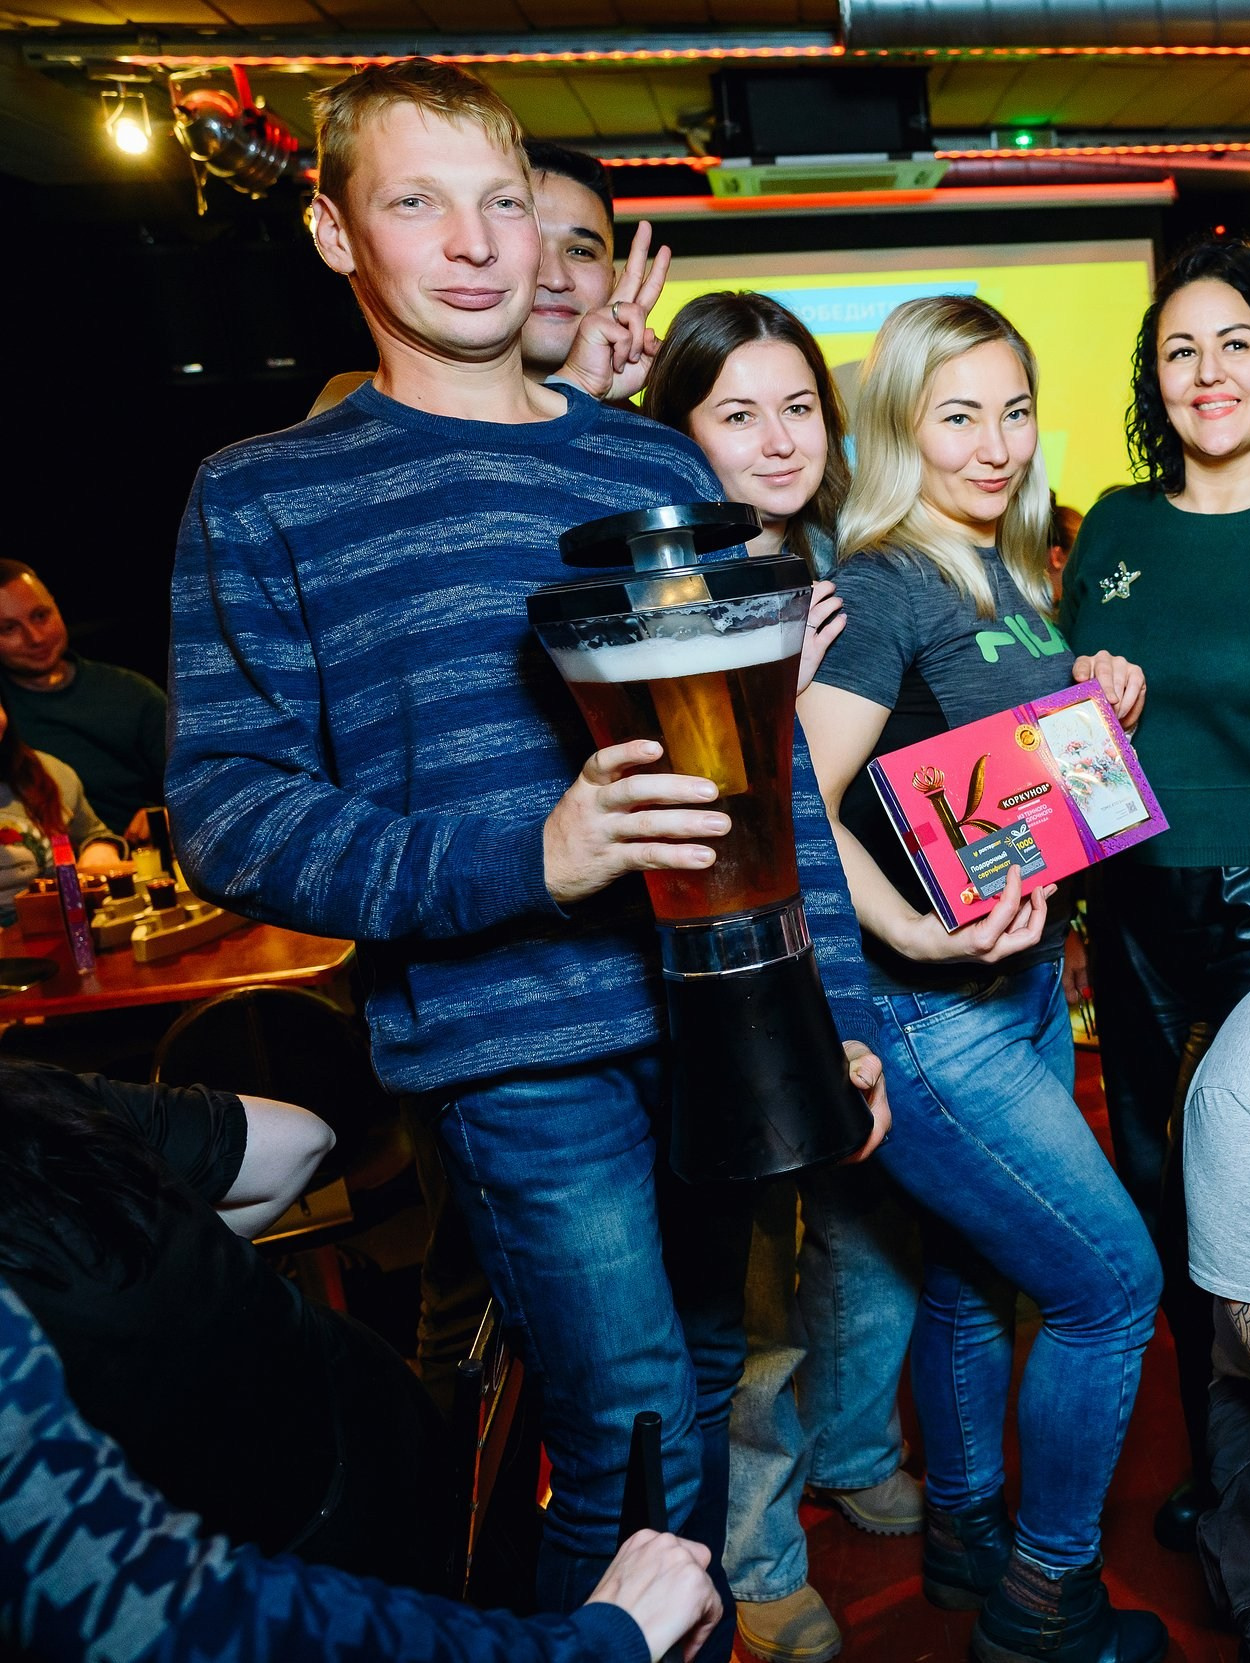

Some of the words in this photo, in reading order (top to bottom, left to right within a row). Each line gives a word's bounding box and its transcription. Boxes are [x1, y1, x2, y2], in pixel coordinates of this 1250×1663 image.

[796, 301, 894, 323] ОБЕДИТ
[1002, 784, 1049, 808] КОРКУНОВ
[1016, 837, 1034, 850] 1000
